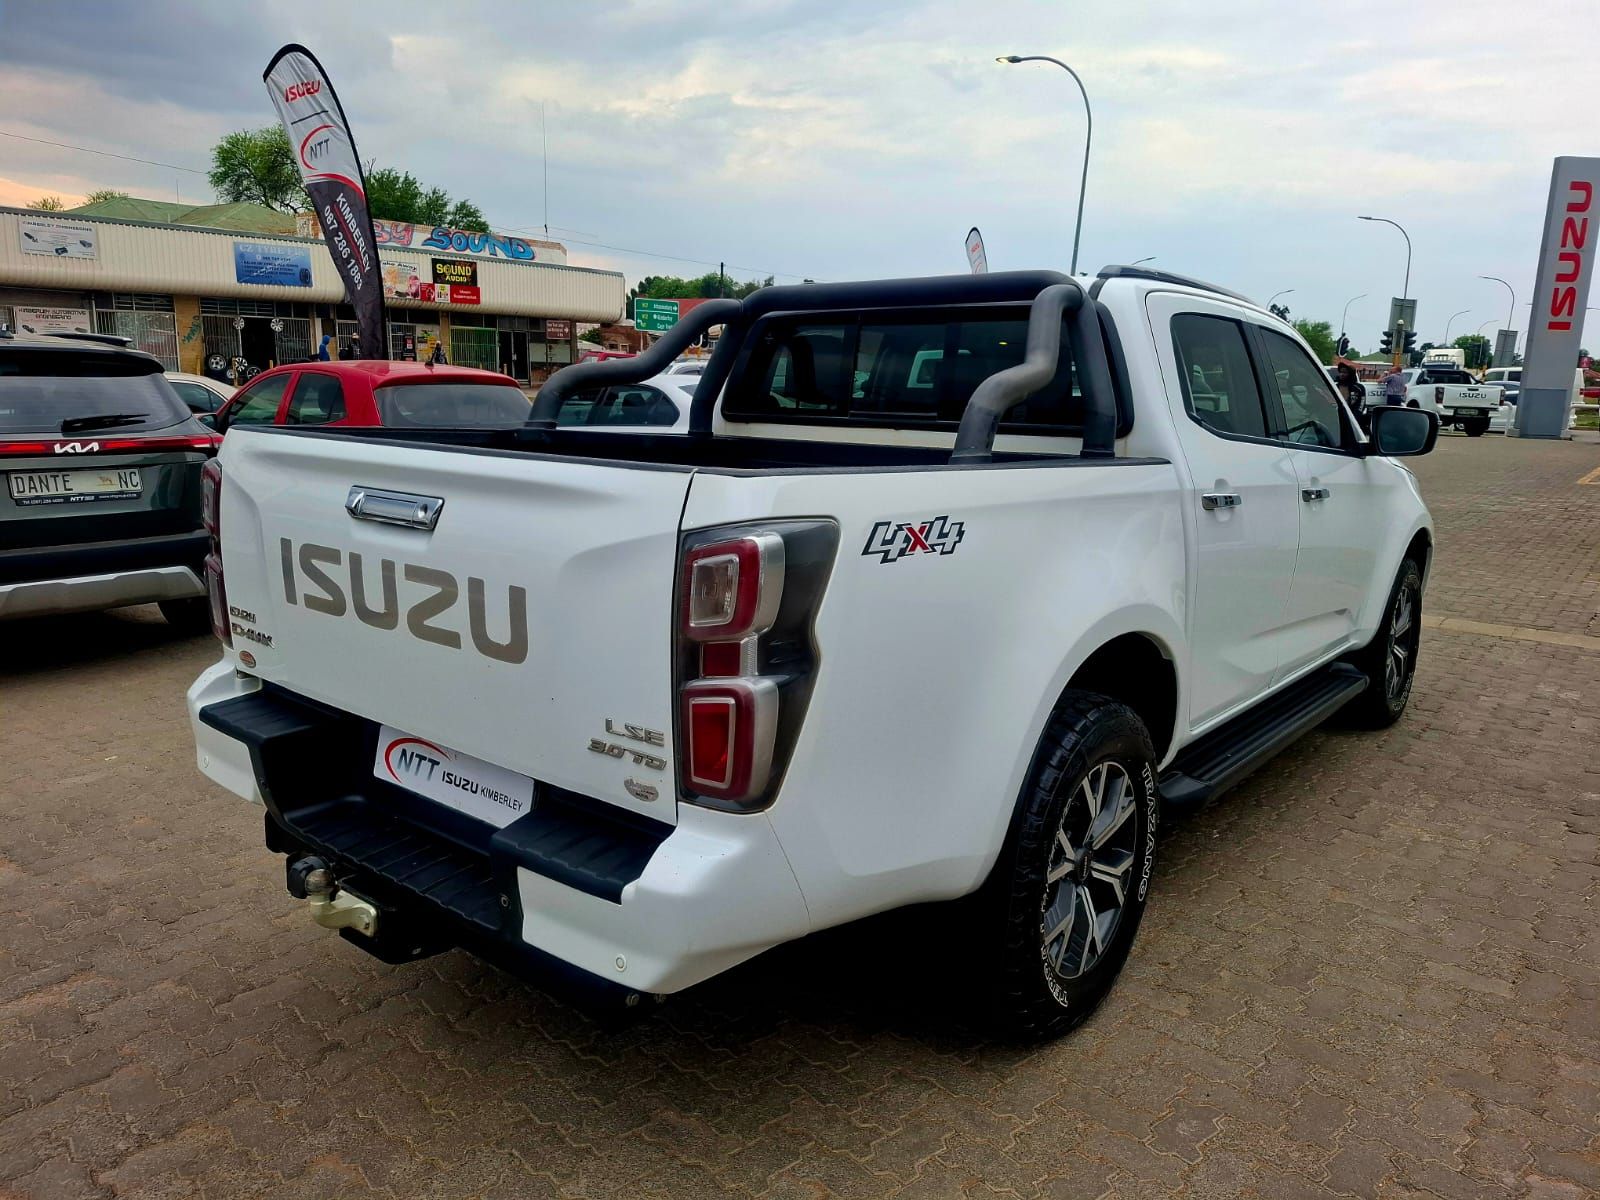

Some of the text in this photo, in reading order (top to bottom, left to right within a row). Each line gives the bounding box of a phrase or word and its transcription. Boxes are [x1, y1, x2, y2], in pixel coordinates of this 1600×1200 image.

[285, 80, 321, 103] ISUZU
[309, 138, 330, 162] NTT
[324, 205, 363, 291] 087 286 1883
[336, 192, 372, 273] KIMBERLEY
[421, 226, 536, 261] SOUND
[436, 263, 472, 277] SOUND
[1547, 180, 1593, 331] ISUZU
[446, 275, 467, 283] AUDIO
[54, 442, 99, 453] KIA
[14, 471, 139, 494] DANTE NC
[280, 537, 529, 665] ISUZU
[605, 718, 665, 748] LSE
[397, 748, 524, 812] NTT ISUZU KIMBERLEY
[1137, 762, 1157, 902] TRAZANO
